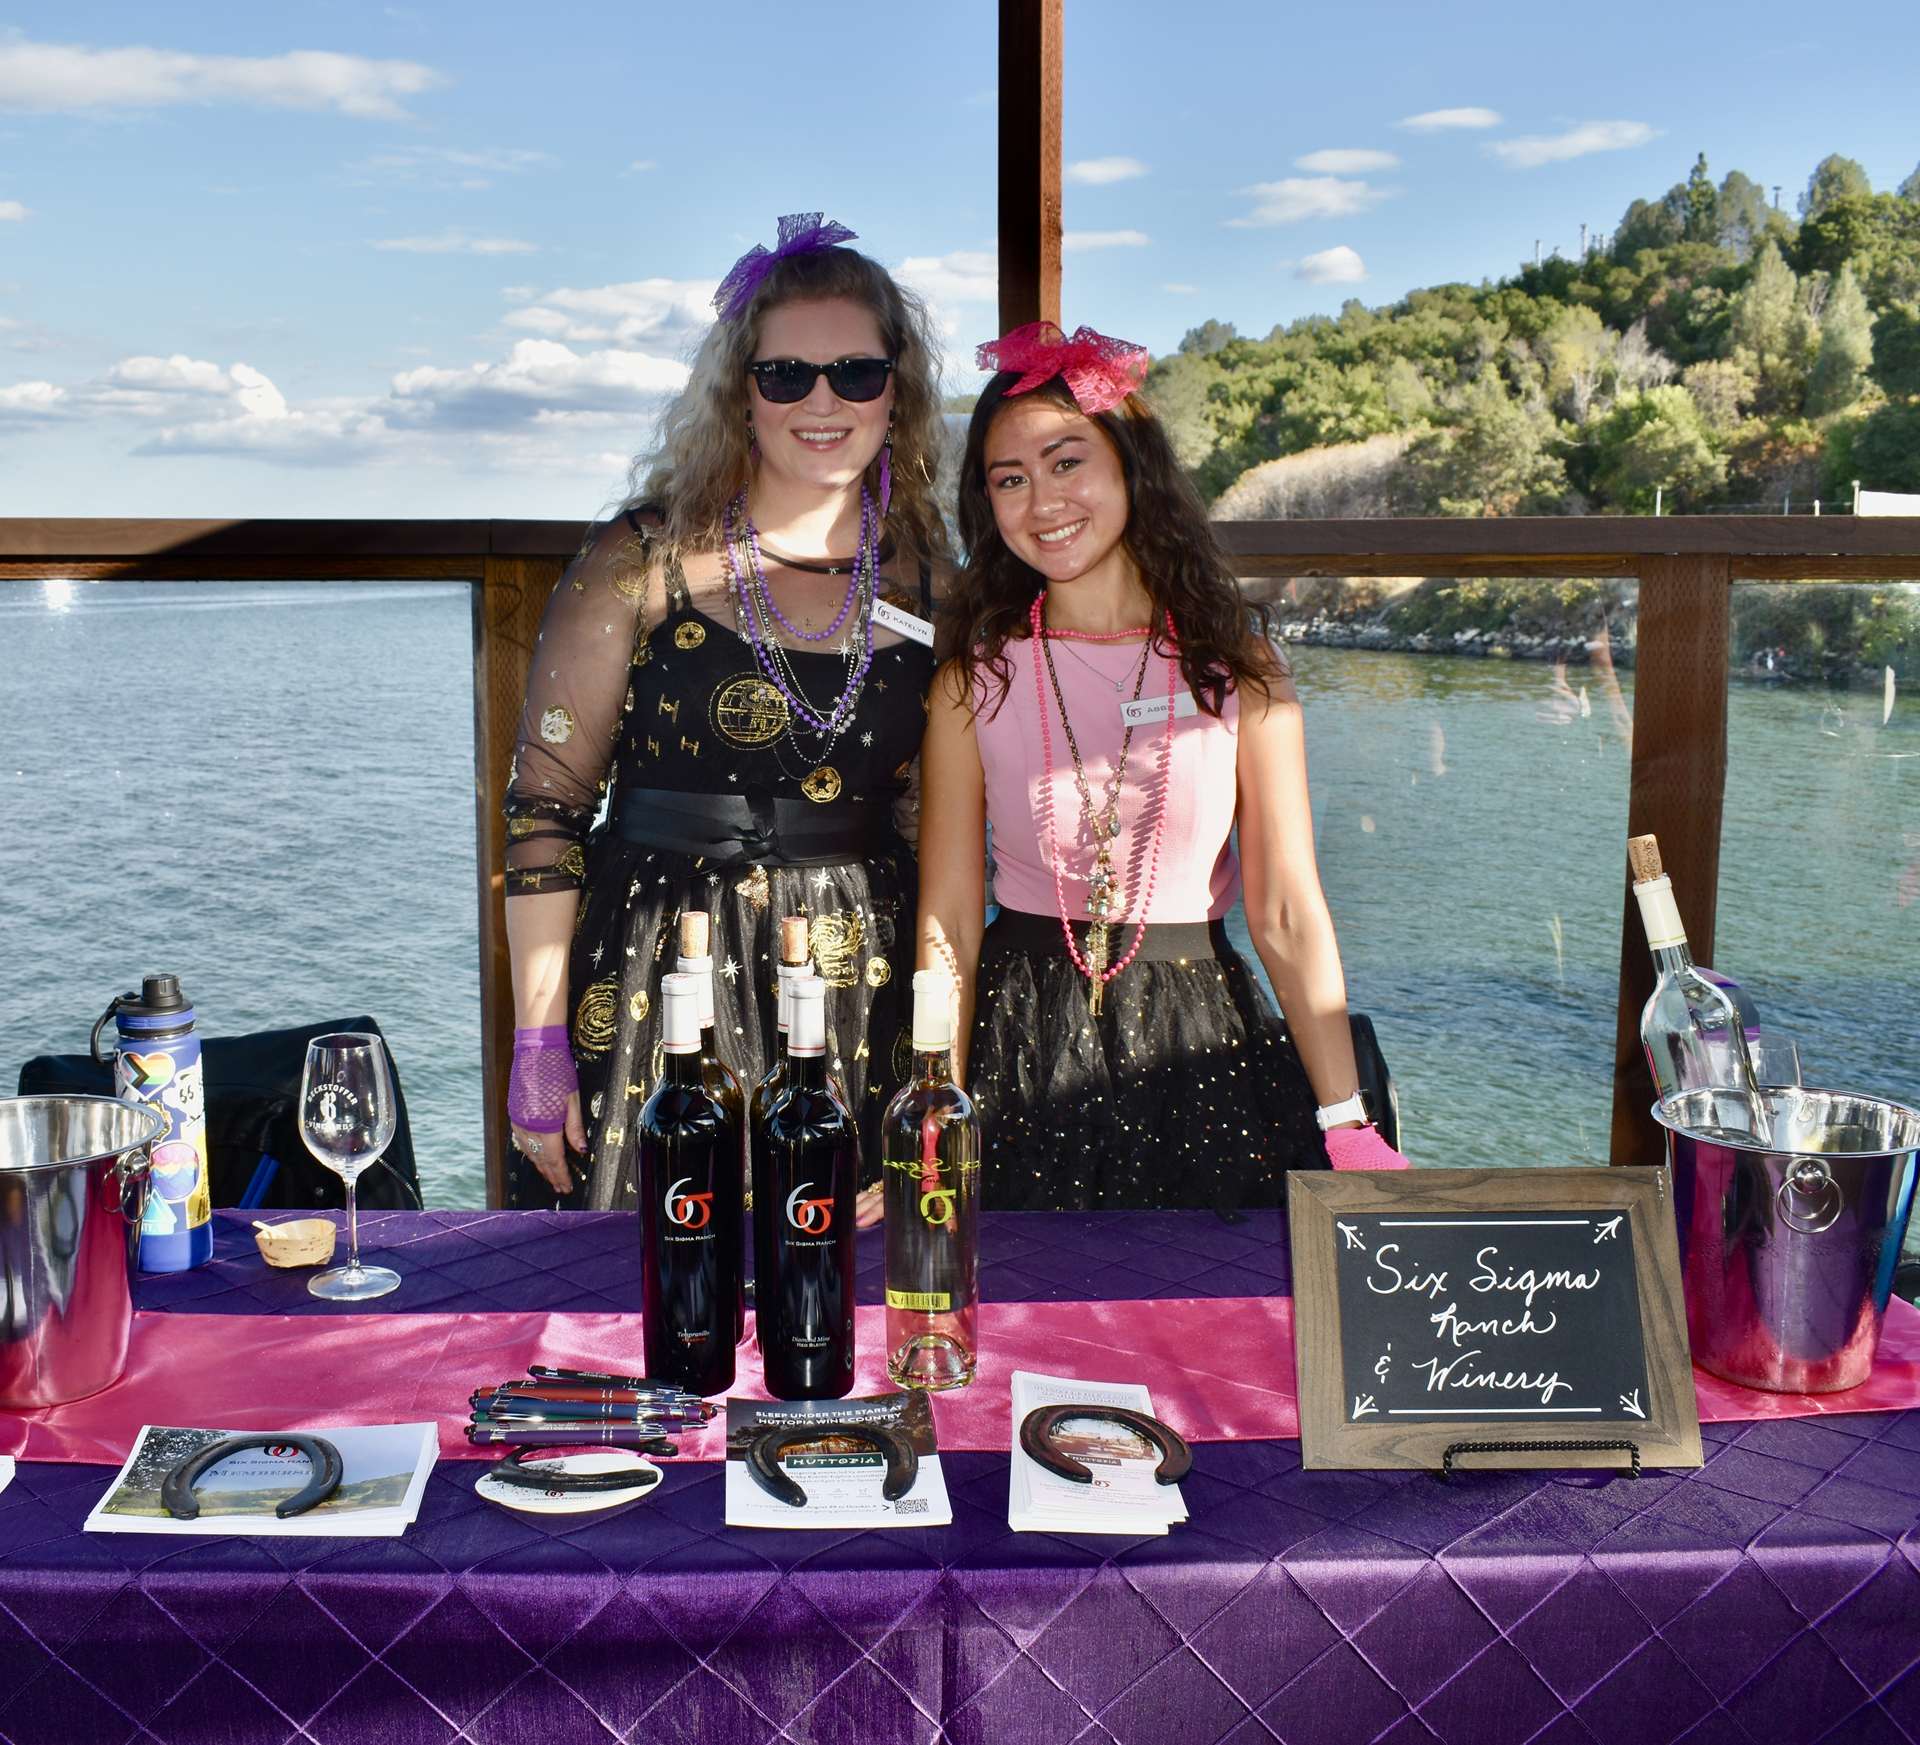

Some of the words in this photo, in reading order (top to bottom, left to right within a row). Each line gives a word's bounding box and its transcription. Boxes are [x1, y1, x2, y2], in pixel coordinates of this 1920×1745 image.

[893, 616, 927, 635] KATELYN
[307, 1083, 359, 1105] BECKSTOFFER
[1366, 1244, 1449, 1299] Six
[1469, 1246, 1601, 1305] Sigma
[1430, 1303, 1557, 1347] Ranch
[1412, 1350, 1573, 1404] Winery
[758, 1418, 814, 1426] HUTTOPIA
[816, 1417, 844, 1425] WINE
[845, 1413, 902, 1423] COUNTRY
[790, 1411, 829, 1419] UNDER
[855, 1407, 887, 1415] STARS
[793, 1457, 876, 1466] HUTTOPIA
